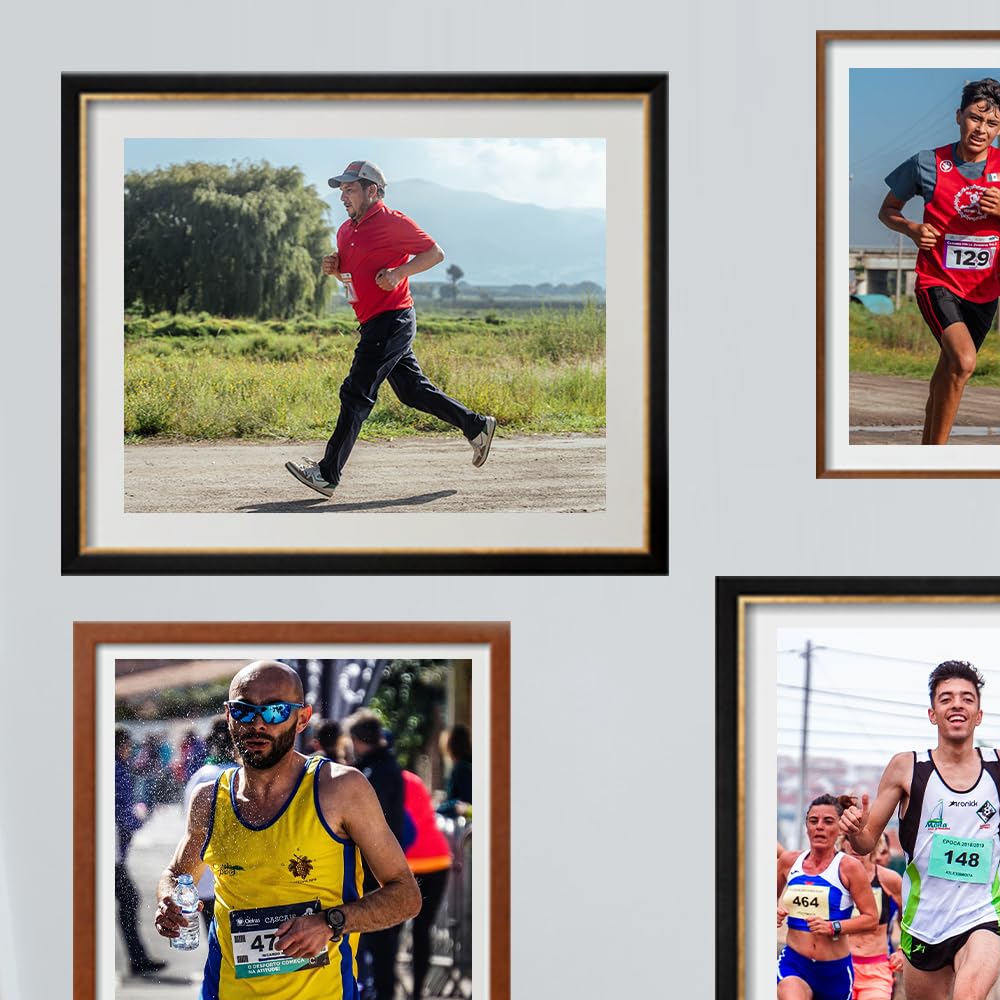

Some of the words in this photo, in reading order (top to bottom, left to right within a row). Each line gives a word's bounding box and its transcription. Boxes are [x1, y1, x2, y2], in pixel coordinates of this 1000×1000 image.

[954, 249, 989, 266] 129
[944, 850, 980, 867] 148
[792, 896, 819, 908] 464
[251, 933, 276, 952] 47
